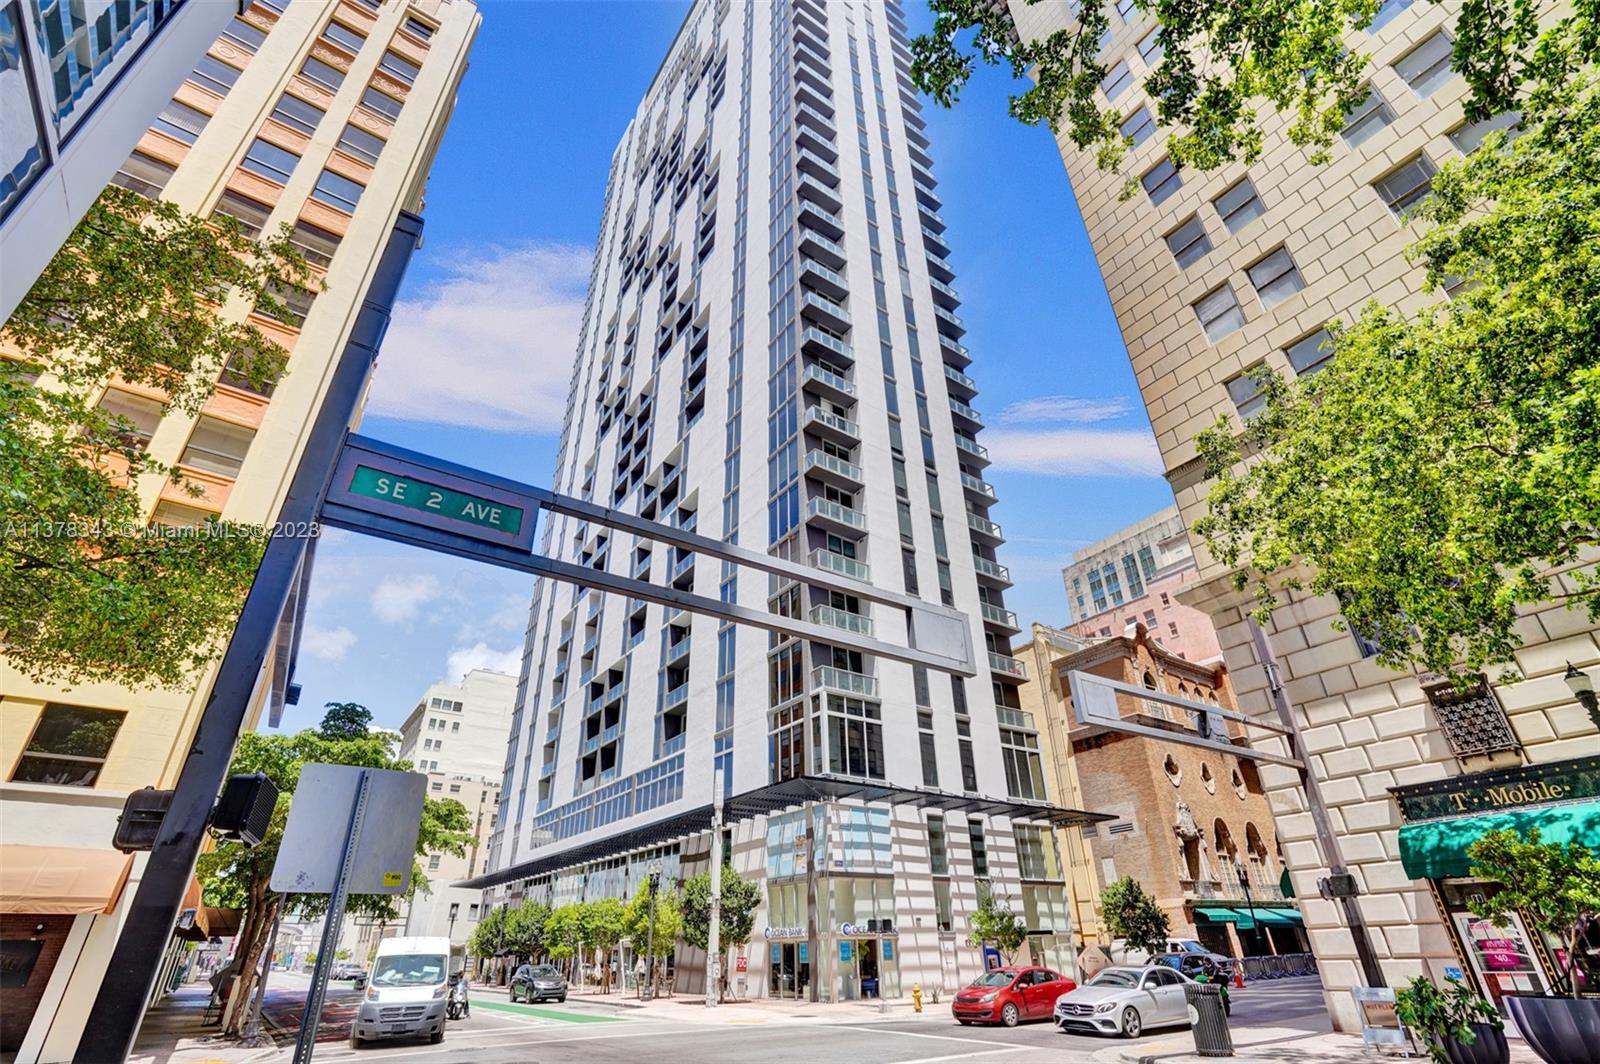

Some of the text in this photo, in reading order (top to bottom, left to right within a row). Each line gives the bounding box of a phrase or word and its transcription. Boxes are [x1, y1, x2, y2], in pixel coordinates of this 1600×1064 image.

[376, 478, 502, 525] SE 2 AVE
